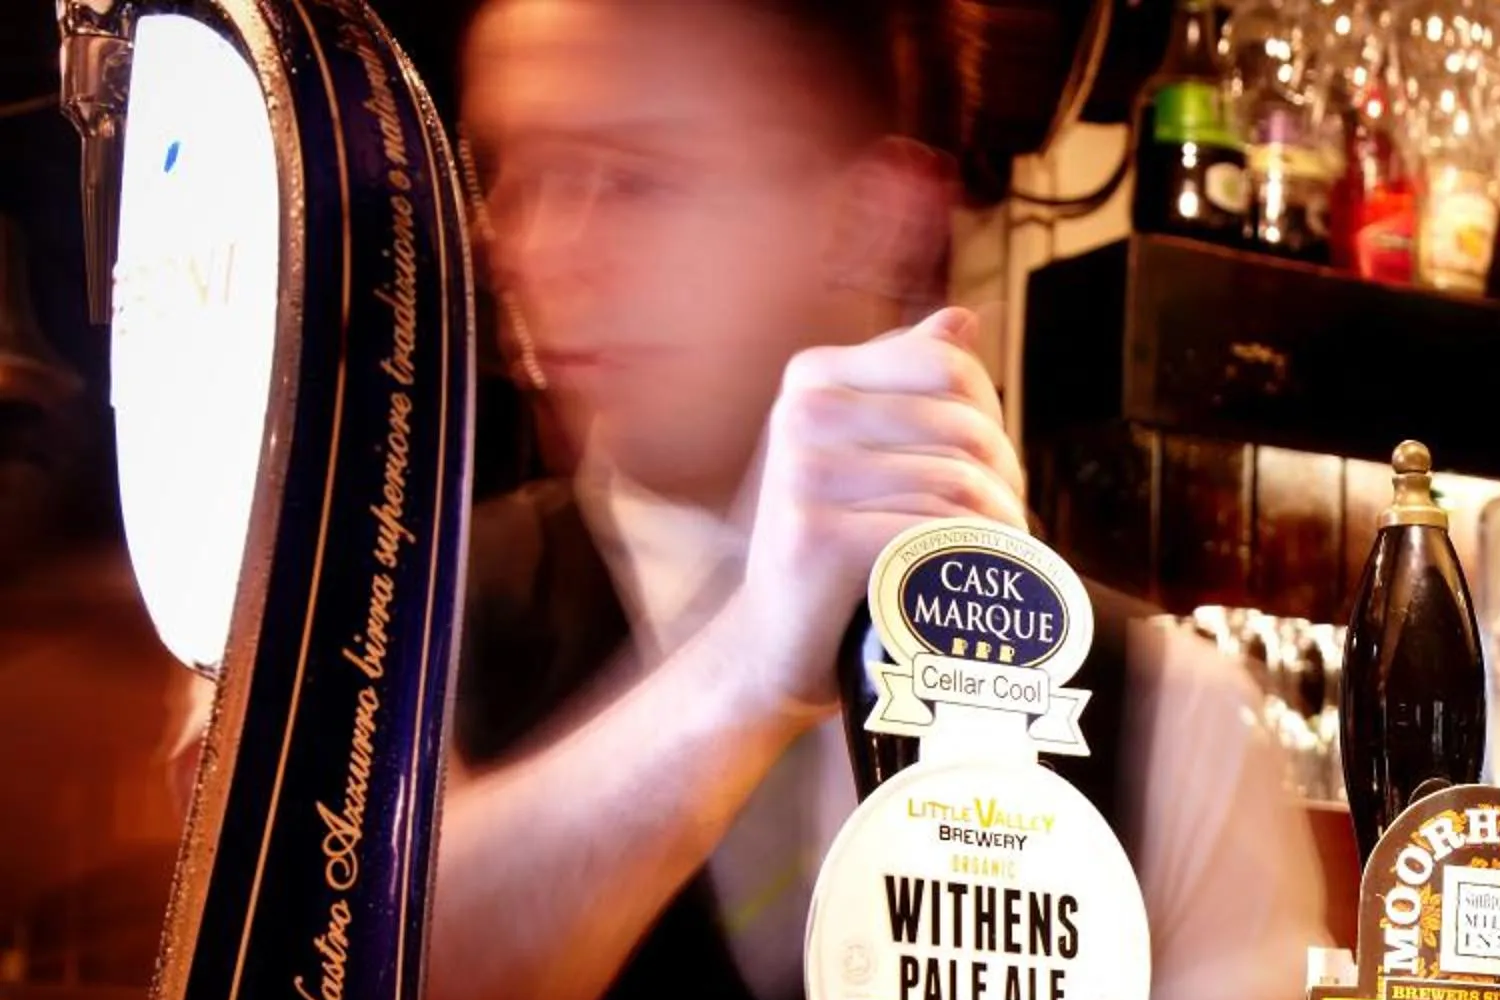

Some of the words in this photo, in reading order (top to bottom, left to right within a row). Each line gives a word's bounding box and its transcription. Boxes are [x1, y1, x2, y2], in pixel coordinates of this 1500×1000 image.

[370, 392, 416, 568] superiore
[941, 561, 1024, 601] CASK
[342, 573, 395, 679] birra
[914, 594, 1053, 642] MARQUE
[921, 665, 984, 698] Cellar
[993, 674, 1042, 704] Cool
[316, 688, 381, 891] Azzurro
[939, 824, 1028, 850] BREWERY
[952, 854, 1016, 880] ORGANIC
[885, 875, 1079, 959] WITHENS
